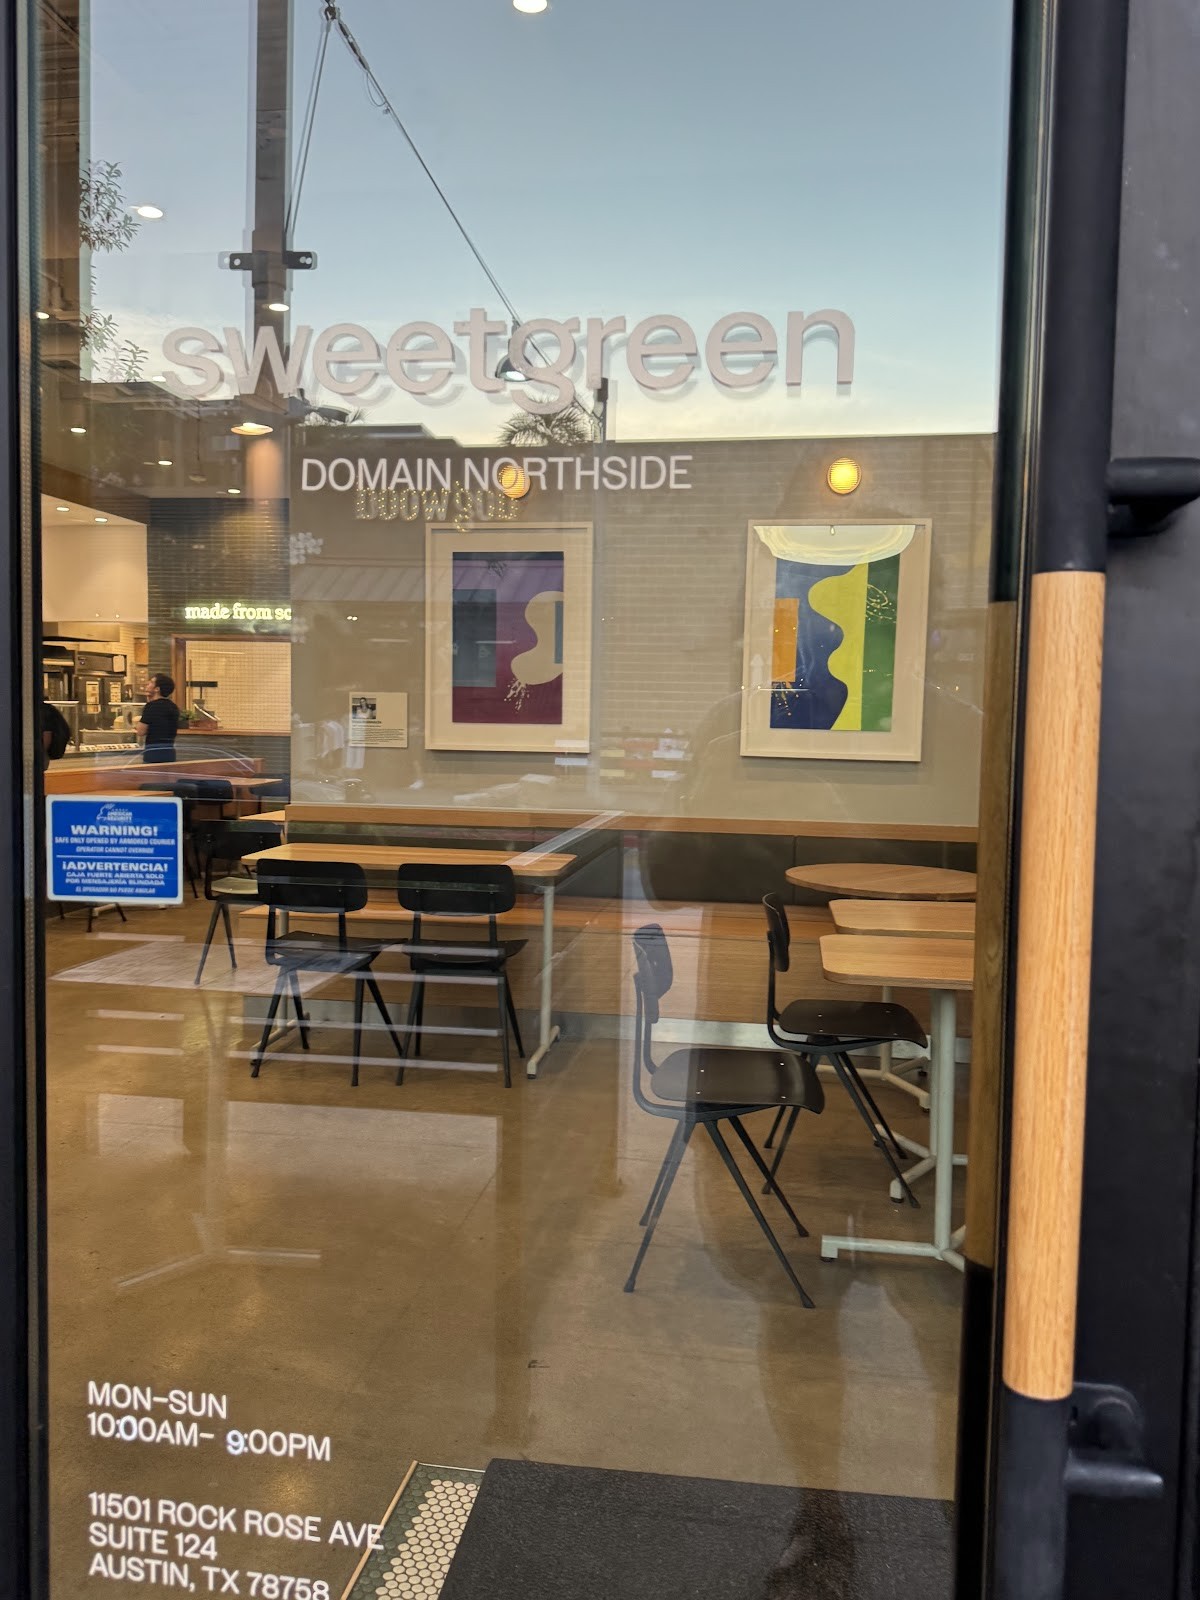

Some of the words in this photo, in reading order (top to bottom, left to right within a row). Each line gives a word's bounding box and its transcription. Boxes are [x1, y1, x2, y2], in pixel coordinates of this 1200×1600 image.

[162, 307, 855, 414] sweetgreen
[301, 457, 451, 491] DOMAIN
[464, 455, 693, 491] NORTHSIDE
[185, 602, 231, 620] made
[232, 602, 273, 620] from
[55, 836, 69, 844] SAFE
[149, 838, 176, 846] COURIER
[70, 825, 158, 837] WARNING!
[62, 861, 168, 872] ¡ADVERTENCIA!
[226, 1428, 332, 1462] 9:00PM
[88, 1492, 151, 1520] 11501
[158, 1499, 237, 1533] ROCK
[244, 1510, 322, 1543] ROSE
[328, 1520, 385, 1550] AVE
[88, 1521, 169, 1555] SUITE
[175, 1532, 218, 1560] 124
[88, 1552, 196, 1592] AUSTIN,
[201, 1565, 240, 1595] TX
[247, 1571, 331, 1600] 78758
